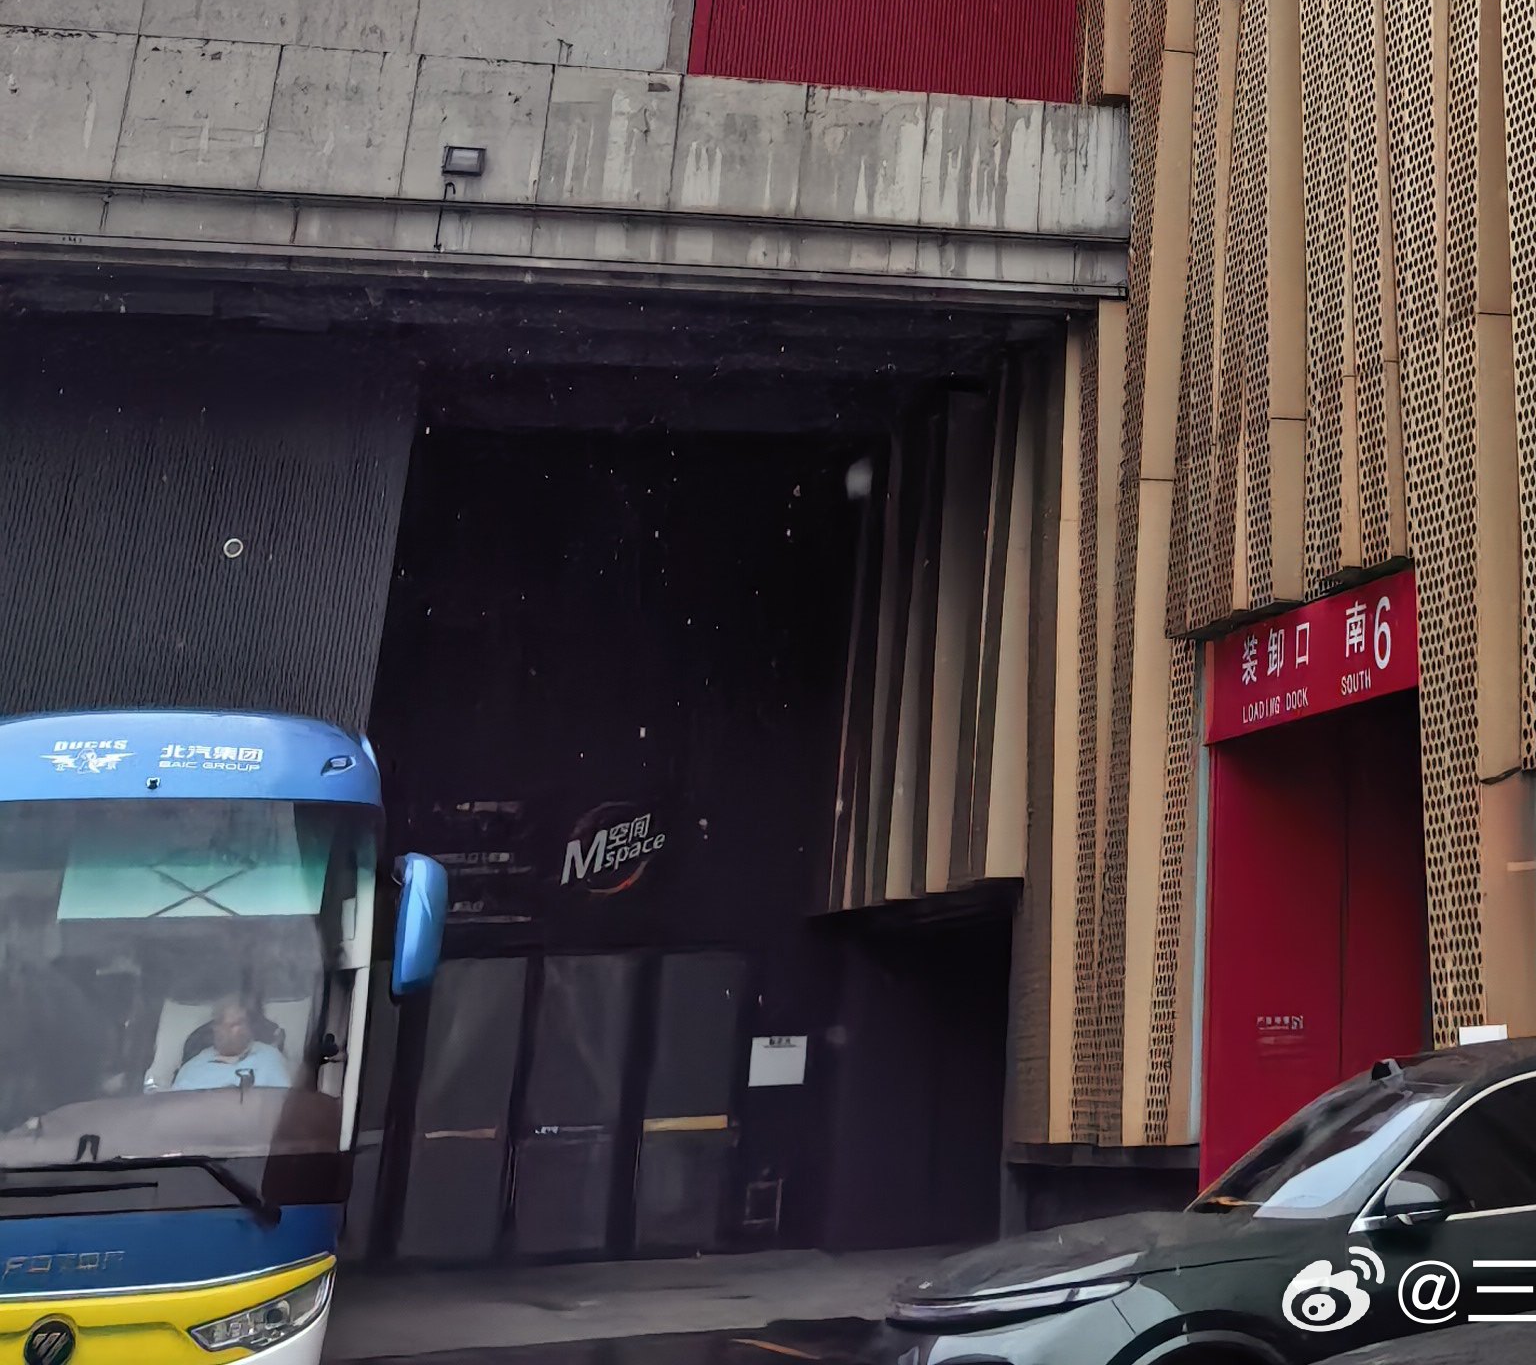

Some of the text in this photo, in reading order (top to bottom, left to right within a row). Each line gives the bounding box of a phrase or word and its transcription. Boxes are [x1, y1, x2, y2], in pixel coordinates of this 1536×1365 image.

[1241, 622, 1310, 685] 装卸口
[1242, 668, 1372, 724] LOADING DOCK SOUTH
[53, 740, 128, 752] DUCKS
[159, 744, 264, 763] 北汽集团
[159, 760, 261, 772] BAIC GROUP
